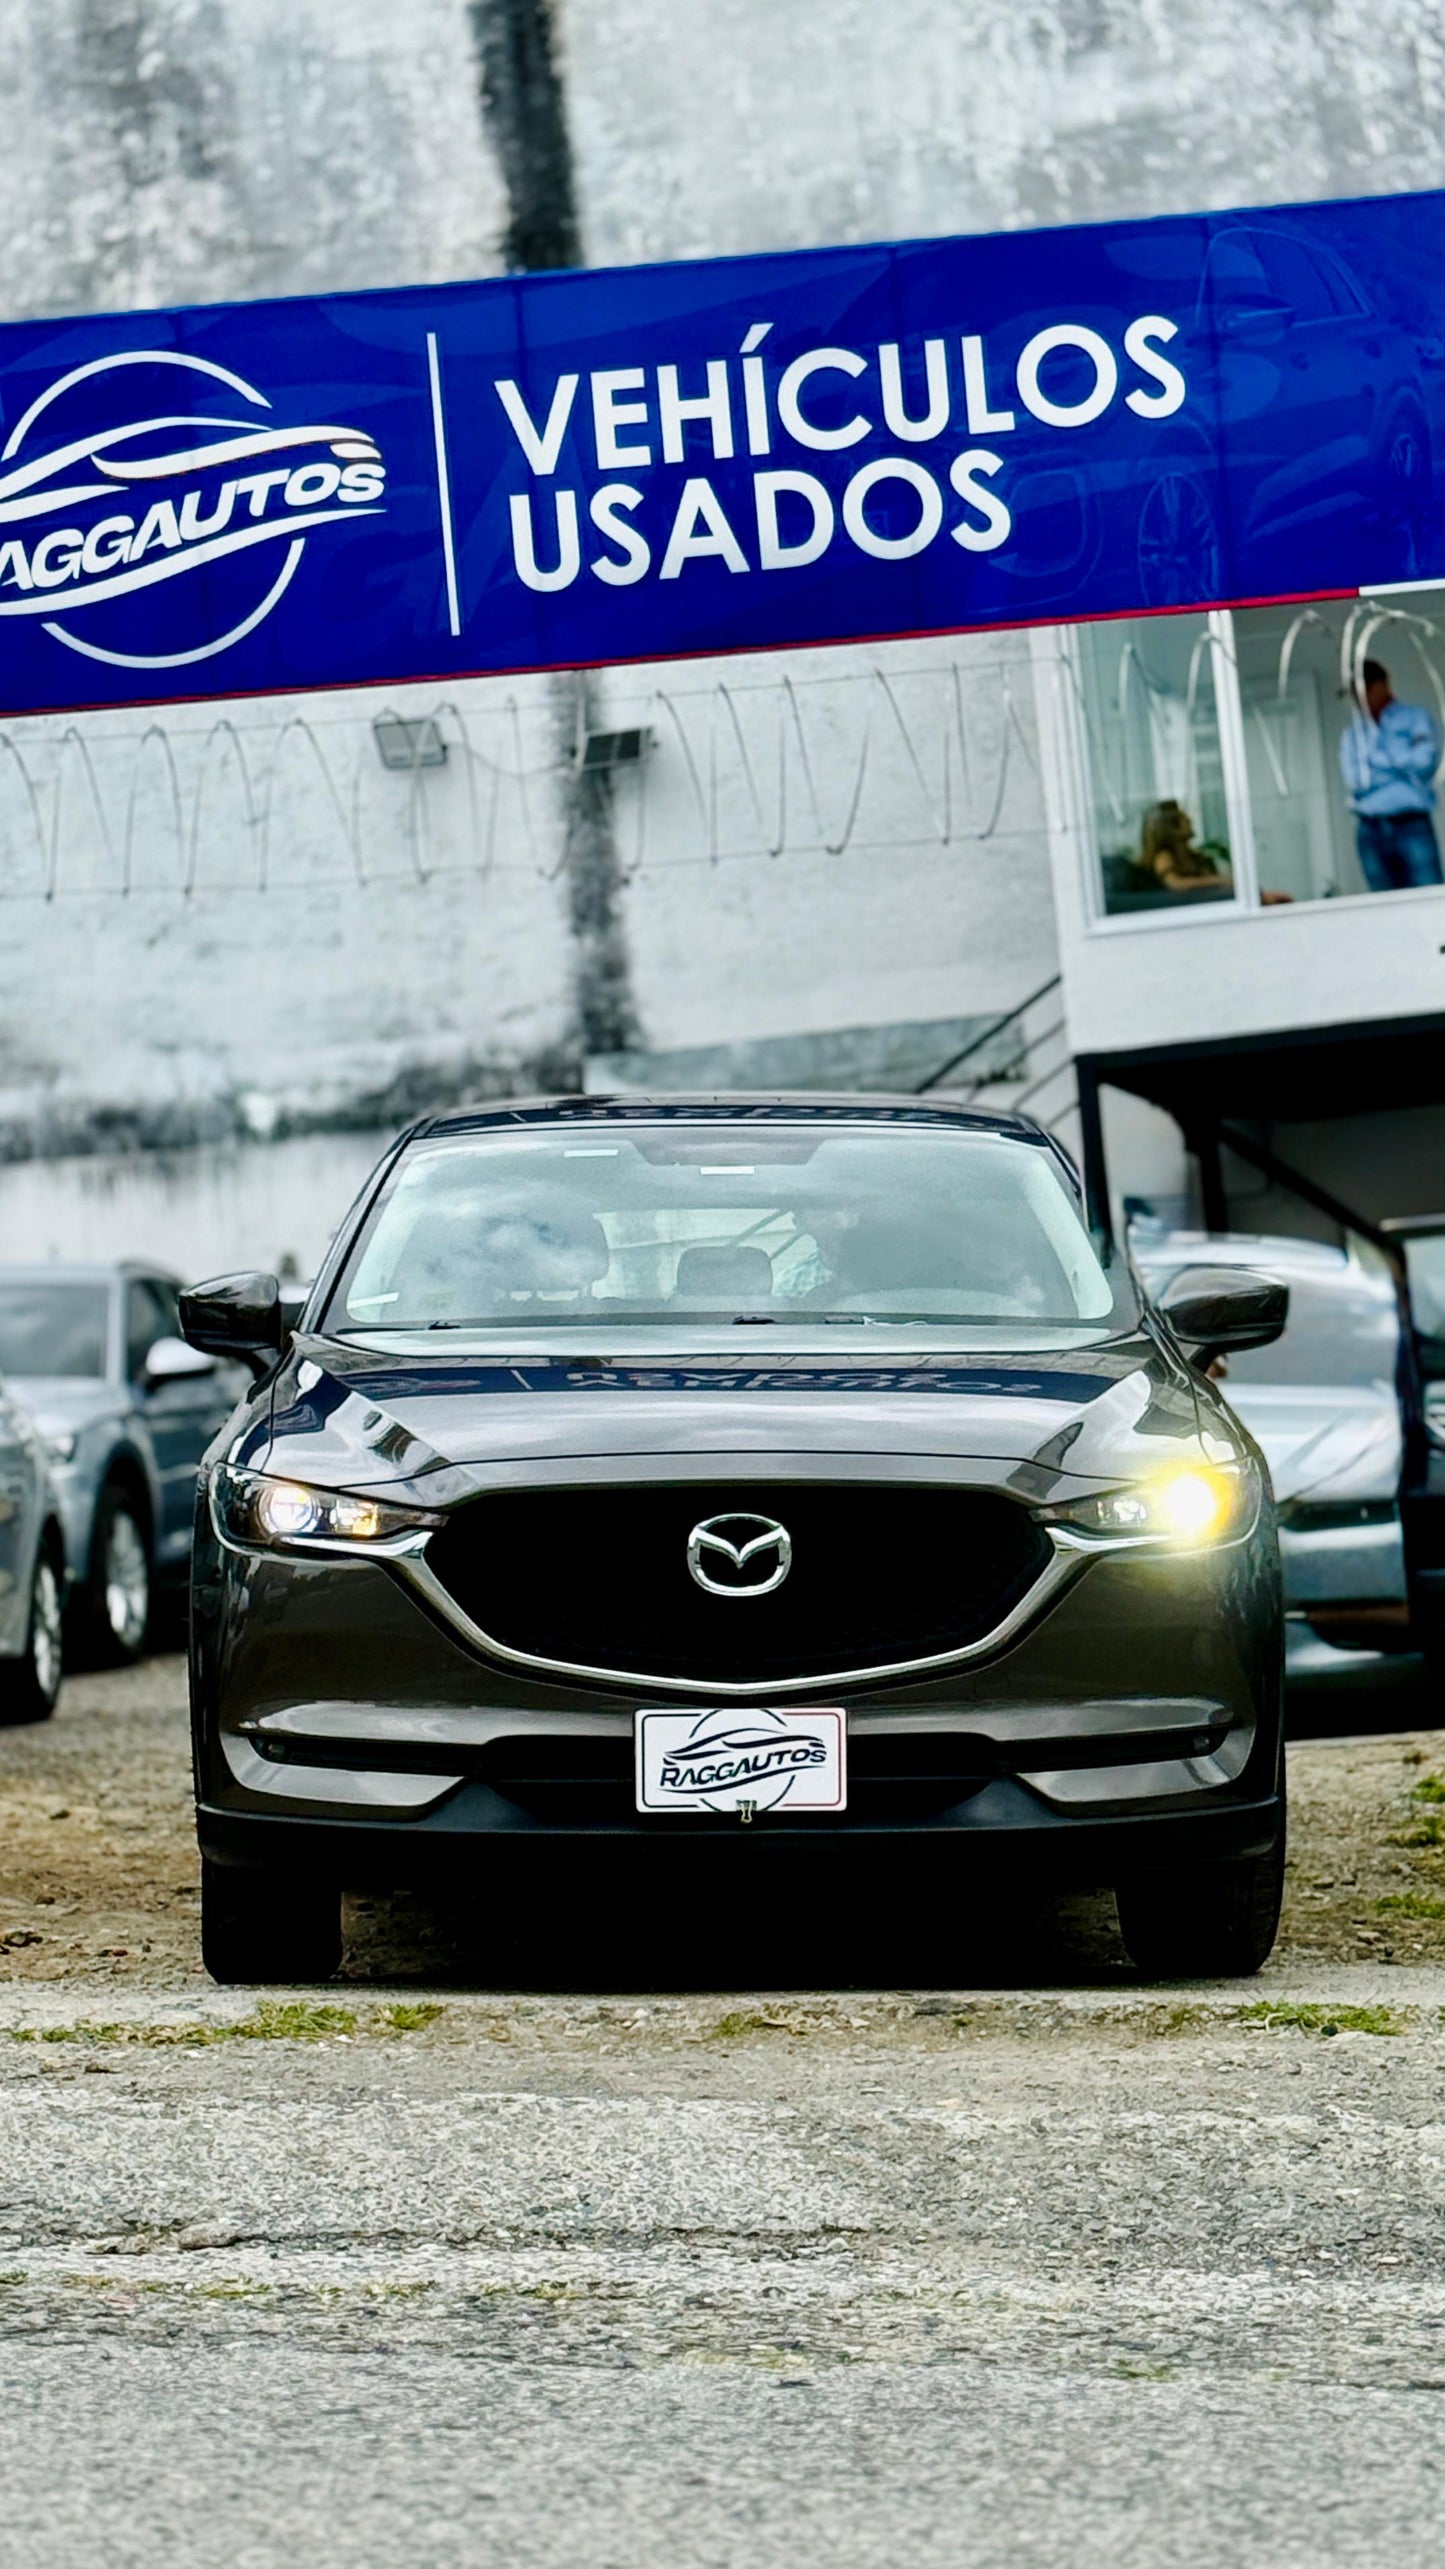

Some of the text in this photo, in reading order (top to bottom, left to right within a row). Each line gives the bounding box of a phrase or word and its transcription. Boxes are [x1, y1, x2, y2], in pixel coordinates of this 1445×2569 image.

[494, 315, 1186, 476] VEHÍCULOS
[0, 463, 386, 590] AGGAUTOS
[509, 449, 1011, 592] USADOS
[660, 1749, 827, 1787] RAGGAUTOS
